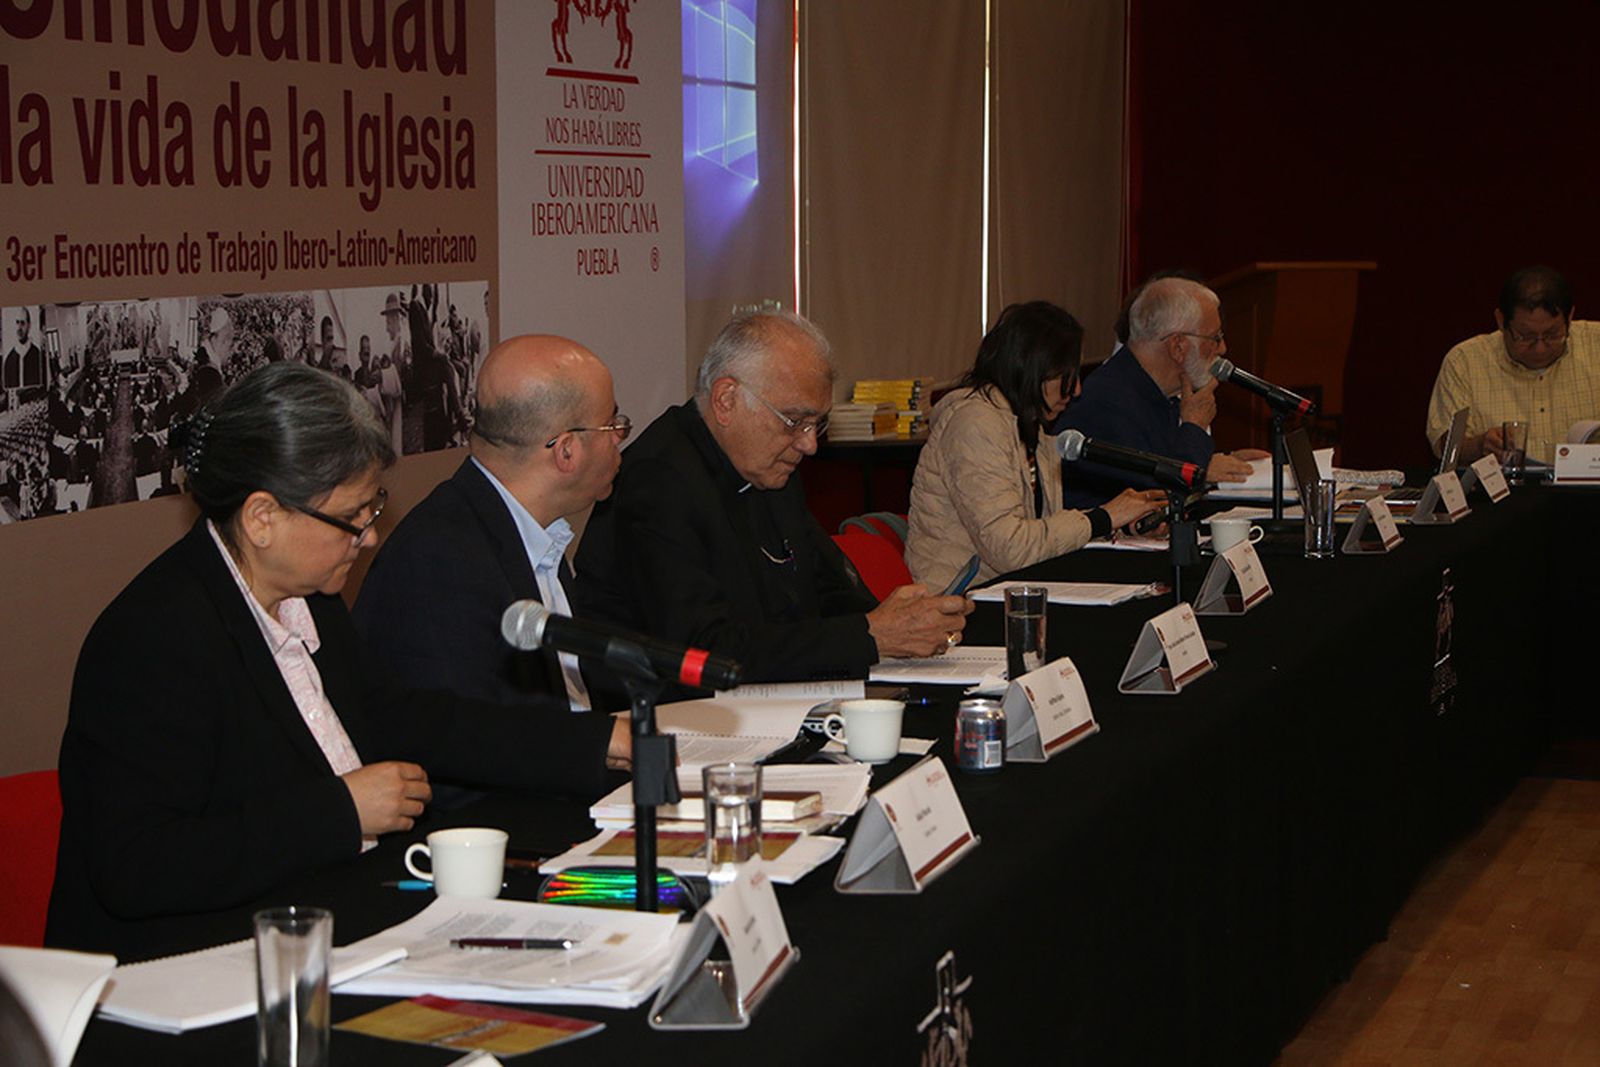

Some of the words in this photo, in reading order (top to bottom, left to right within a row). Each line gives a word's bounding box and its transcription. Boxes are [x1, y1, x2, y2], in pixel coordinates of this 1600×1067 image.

[563, 83, 578, 109] LA
[581, 85, 625, 112] VERDAD
[0, 64, 53, 186] la
[73, 71, 194, 187] vida
[213, 81, 271, 188] de
[288, 86, 327, 189] la
[344, 90, 476, 212] Iglesia
[546, 117, 570, 144] NOS
[572, 114, 604, 146] HARÁ
[606, 122, 642, 147] LIBRES
[547, 165, 645, 198] UNIVERSIDAD
[531, 202, 660, 236] IBEROAMERICANA
[6, 236, 47, 282] 3er
[54, 233, 170, 280] Encuentro
[176, 231, 201, 275] de
[207, 230, 278, 280] Trabajo
[284, 228, 477, 271] Ibero-Latino-Americano
[577, 248, 620, 275] PUEBLA
